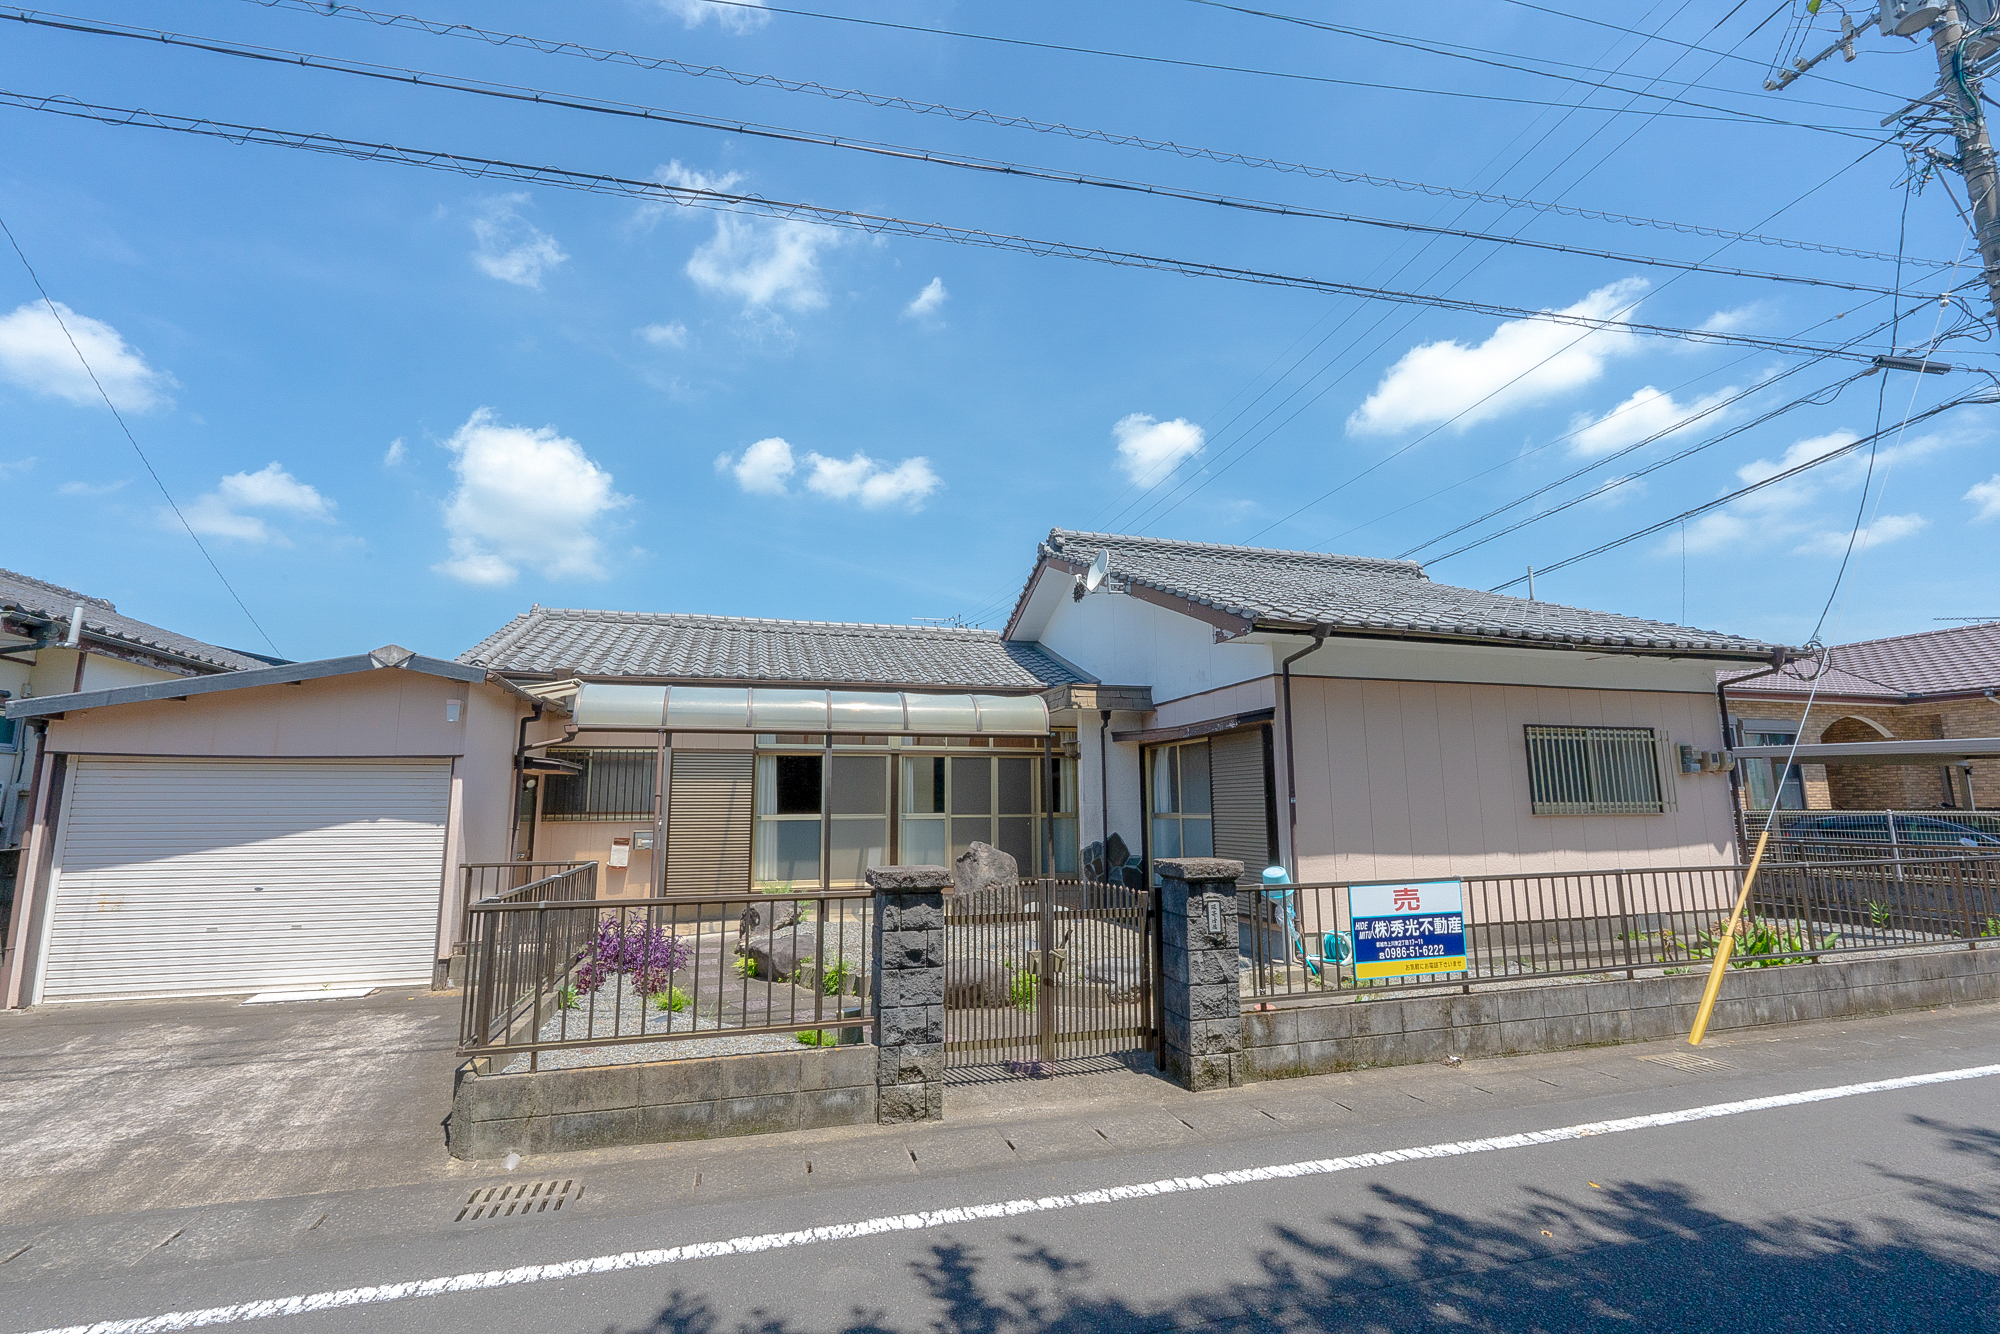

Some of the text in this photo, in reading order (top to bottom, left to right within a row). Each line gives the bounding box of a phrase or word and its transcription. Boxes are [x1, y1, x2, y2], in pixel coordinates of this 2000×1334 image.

[1393, 888, 1420, 911] 売
[1355, 921, 1369, 931] HIDE
[1371, 916, 1463, 939] (株)秀光不動産
[1359, 931, 1372, 940] MITU
[1385, 944, 1444, 959] 0986-51-6222
[1405, 960, 1462, 971] お気軽にお電話下さいませ
